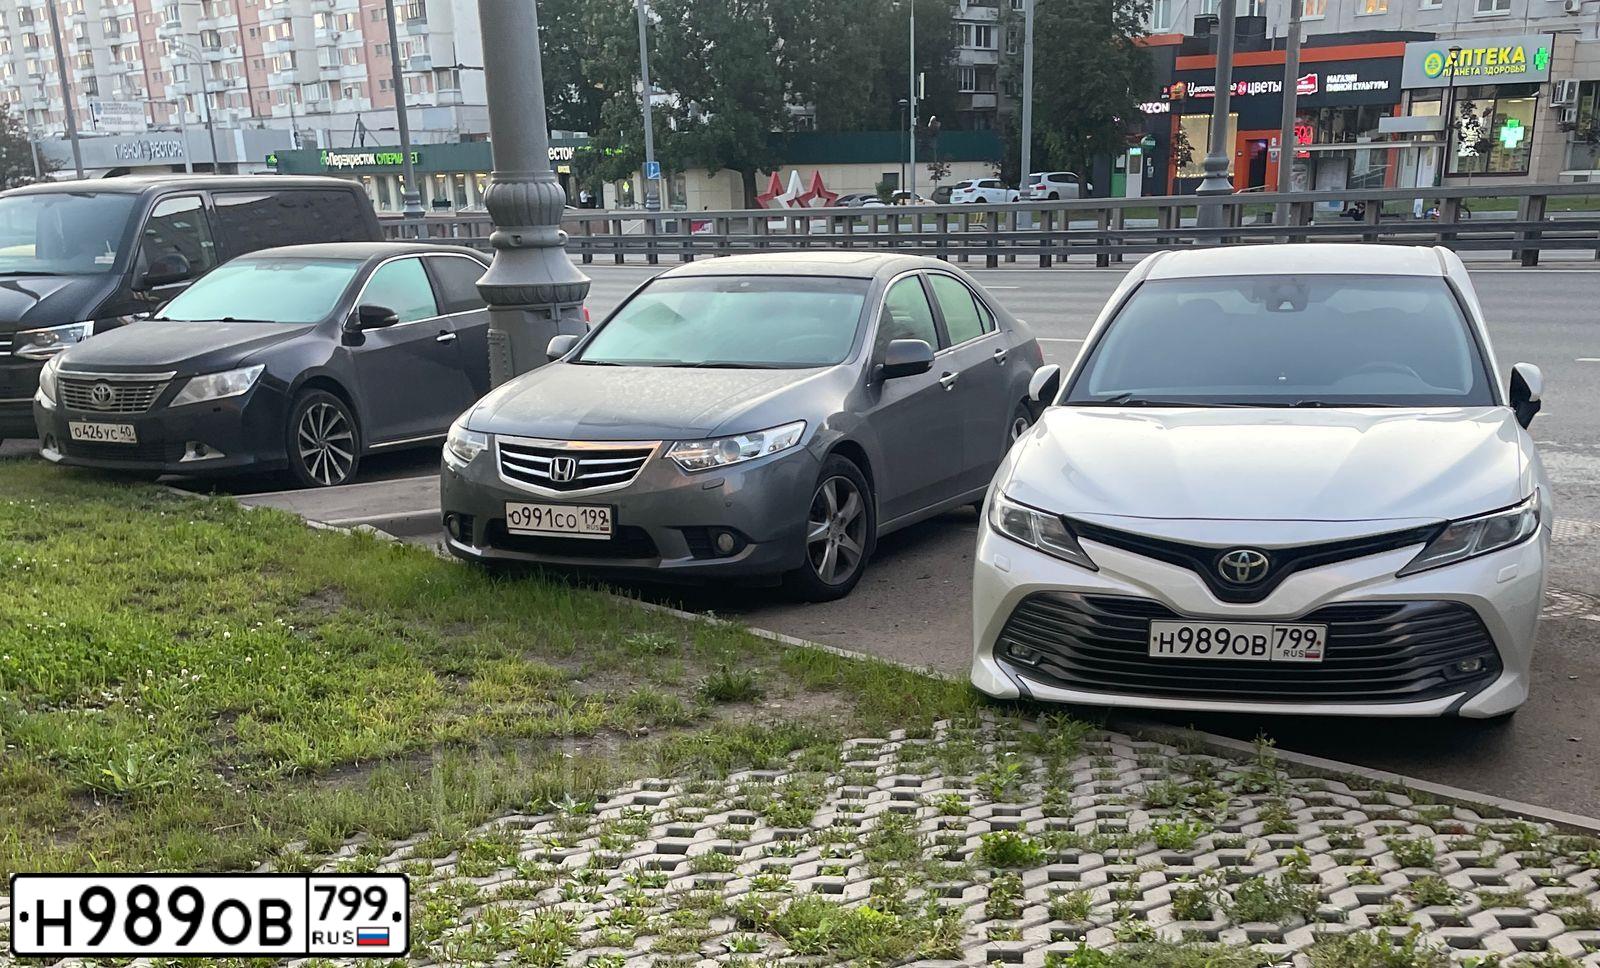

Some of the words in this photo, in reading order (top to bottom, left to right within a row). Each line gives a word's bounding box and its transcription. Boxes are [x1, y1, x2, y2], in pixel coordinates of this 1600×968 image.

[1445, 46, 1525, 67] АПТЕКА
[1484, 65, 1526, 75] ЗДОРОВЬЯ
[1327, 74, 1357, 83] МАГАЗИН
[1326, 82, 1352, 92] ПИВНОЙ
[1353, 81, 1388, 90] КУЛЬТУРЫ
[1139, 102, 1171, 114] OZON
[149, 140, 184, 159] РЕСТОРА
[376, 151, 418, 165] СУПЕРМАЕТ
[580, 508, 607, 526] 199
[1158, 626, 1268, 656] Н989ОВ
[1275, 628, 1318, 650] 799
[1283, 650, 1304, 658] RUS
